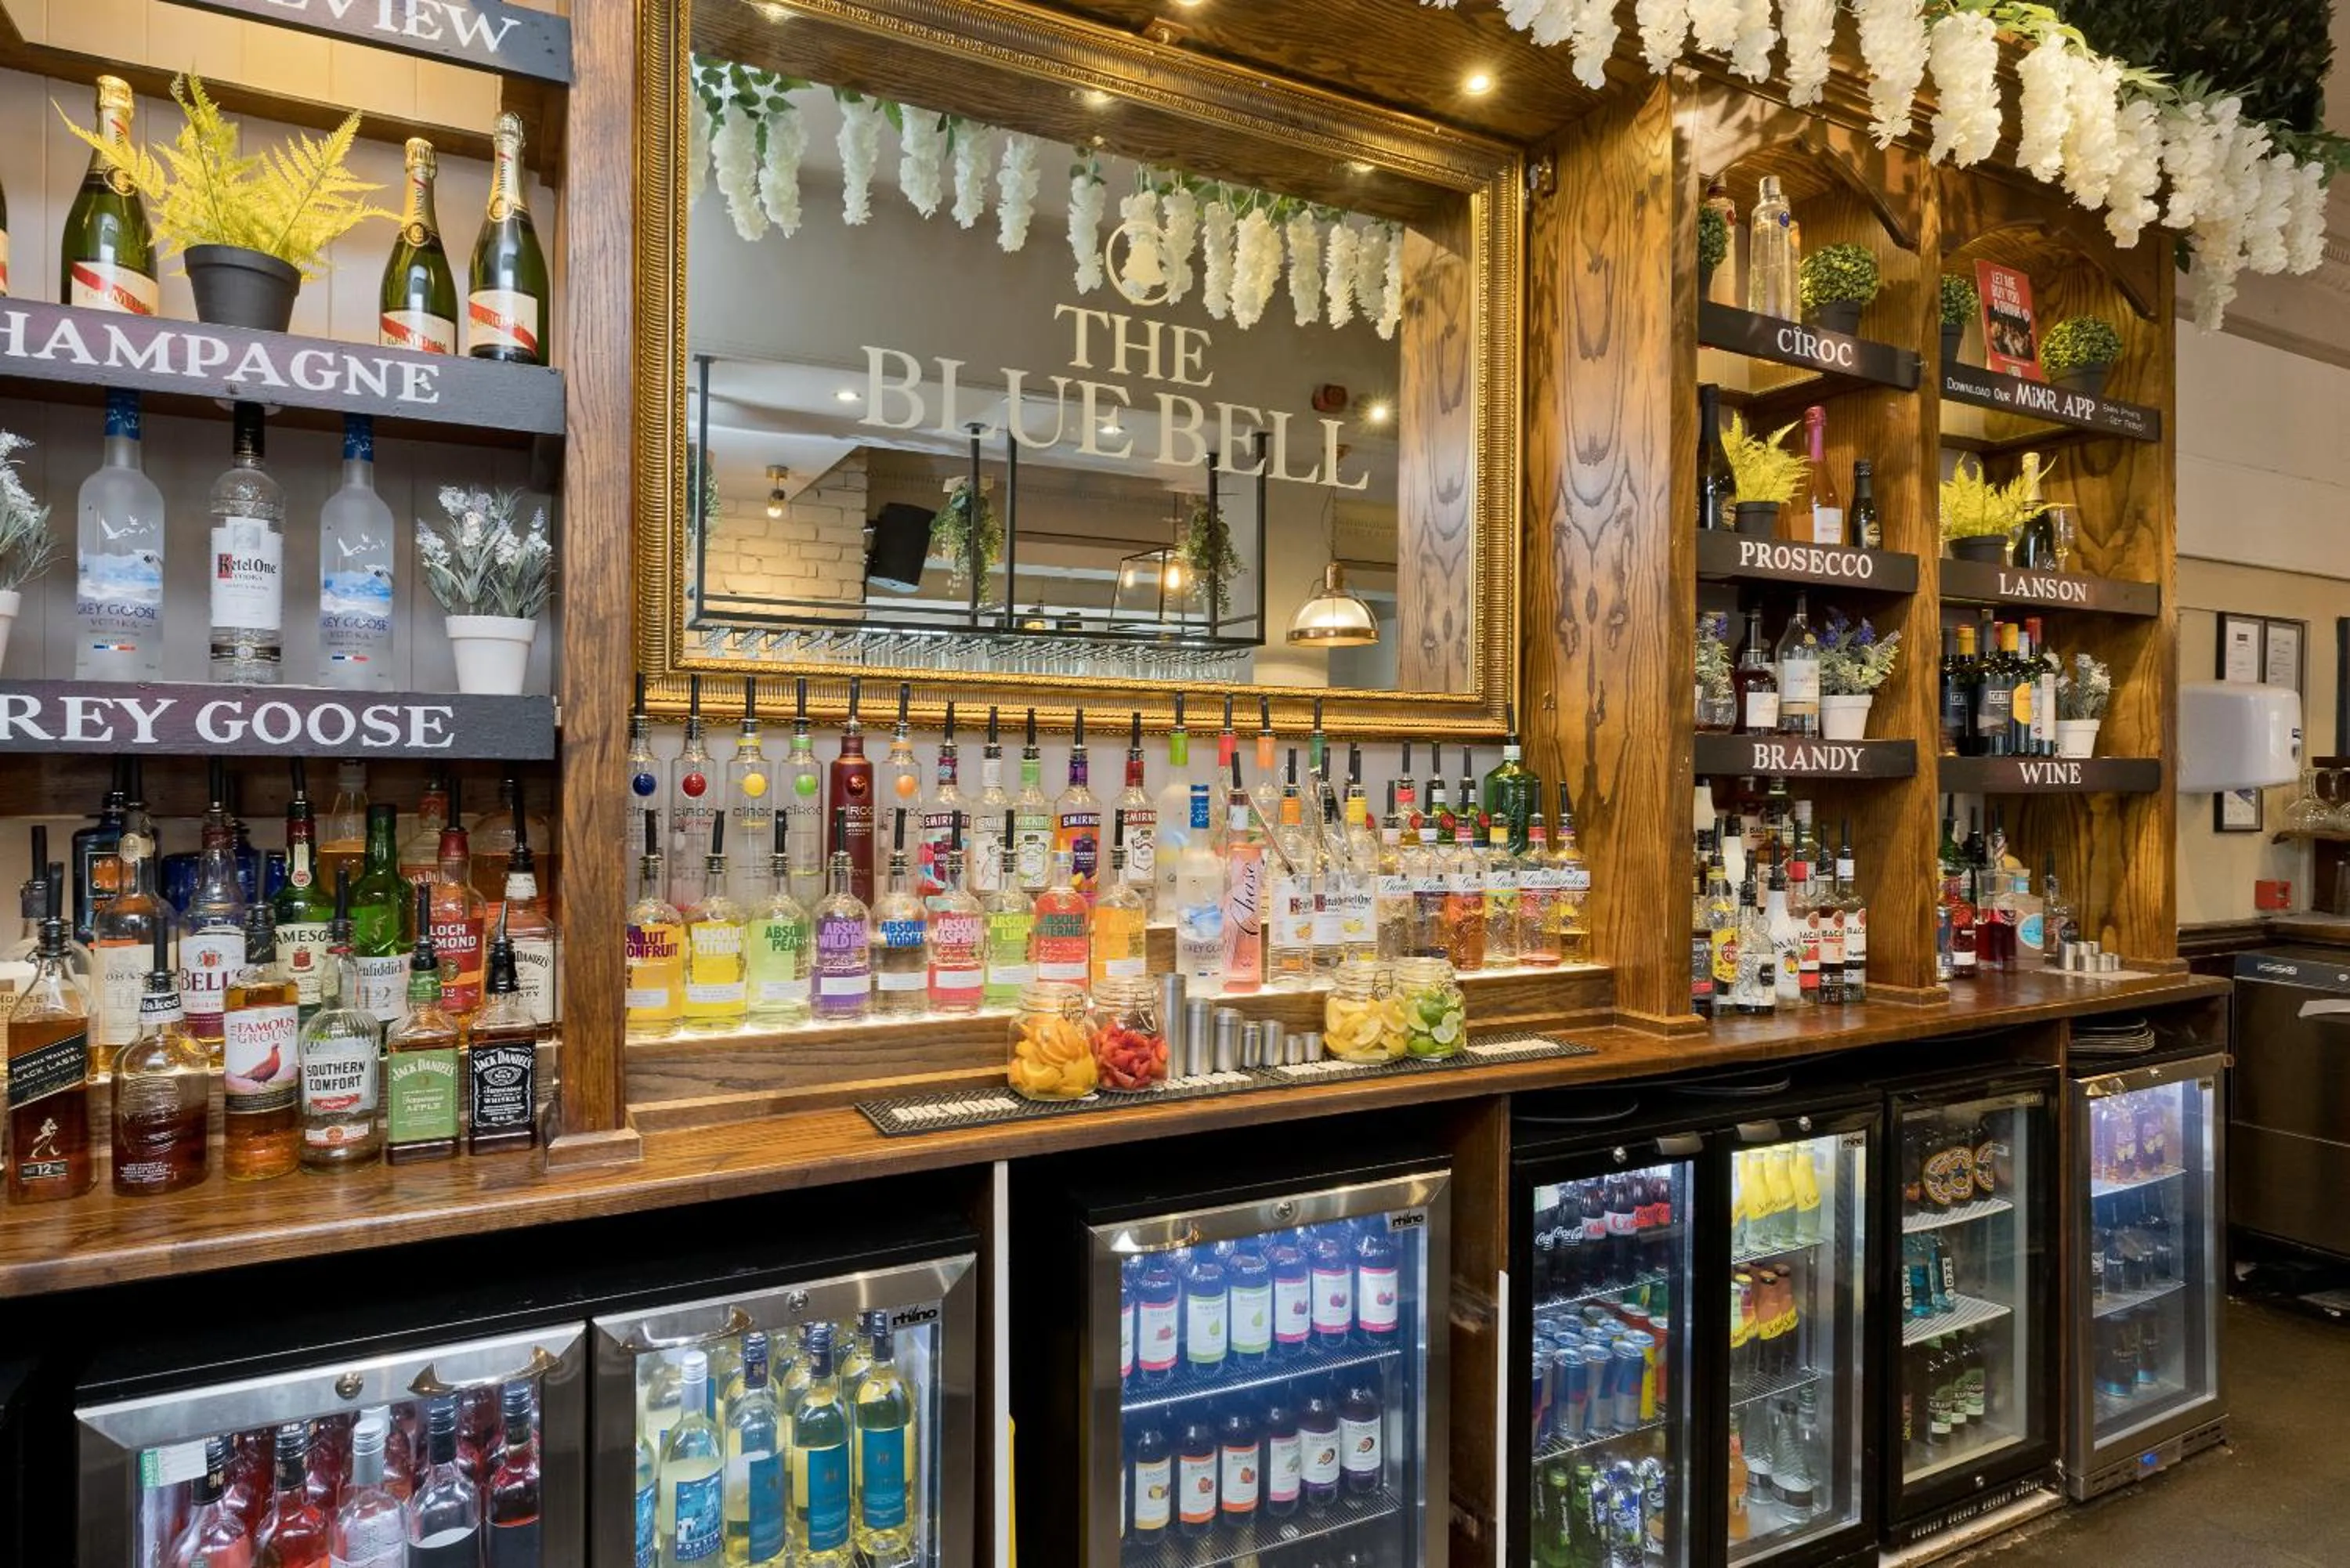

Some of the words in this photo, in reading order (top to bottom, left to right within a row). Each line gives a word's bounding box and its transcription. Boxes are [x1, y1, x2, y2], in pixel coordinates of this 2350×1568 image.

[1054, 303, 1214, 388] THE
[2062, 393, 2096, 421] APP
[859, 345, 1134, 460] BLUE
[1153, 392, 1371, 491] BELL
[218, 553, 253, 578] Ketel
[254, 558, 277, 574] One
[1740, 541, 1873, 579] PROSECCO
[1998, 573, 2087, 602] LANSON
[194, 699, 455, 749] GOOSE
[1753, 743, 1865, 772] BRANDY
[2018, 763, 2082, 784] WINE
[430, 924, 466, 937] LOCH
[627, 930, 667, 944] SOLUT
[432, 936, 477, 949] MOND
[627, 942, 679, 958] ONFRUIT
[237, 1017, 295, 1035] FAMOUS
[237, 1028, 295, 1044] GROUSE
[47, 1053, 85, 1071] LABEL
[306, 1060, 366, 1077] SOUTHERN
[473, 1054, 497, 1074] JACK
[497, 1050, 533, 1070] DANIEL'S
[393, 1063, 418, 1082] JACK
[309, 1075, 363, 1091] COMFORT
[37, 1162, 52, 1175] 12
[892, 1304, 938, 1326] rhino
